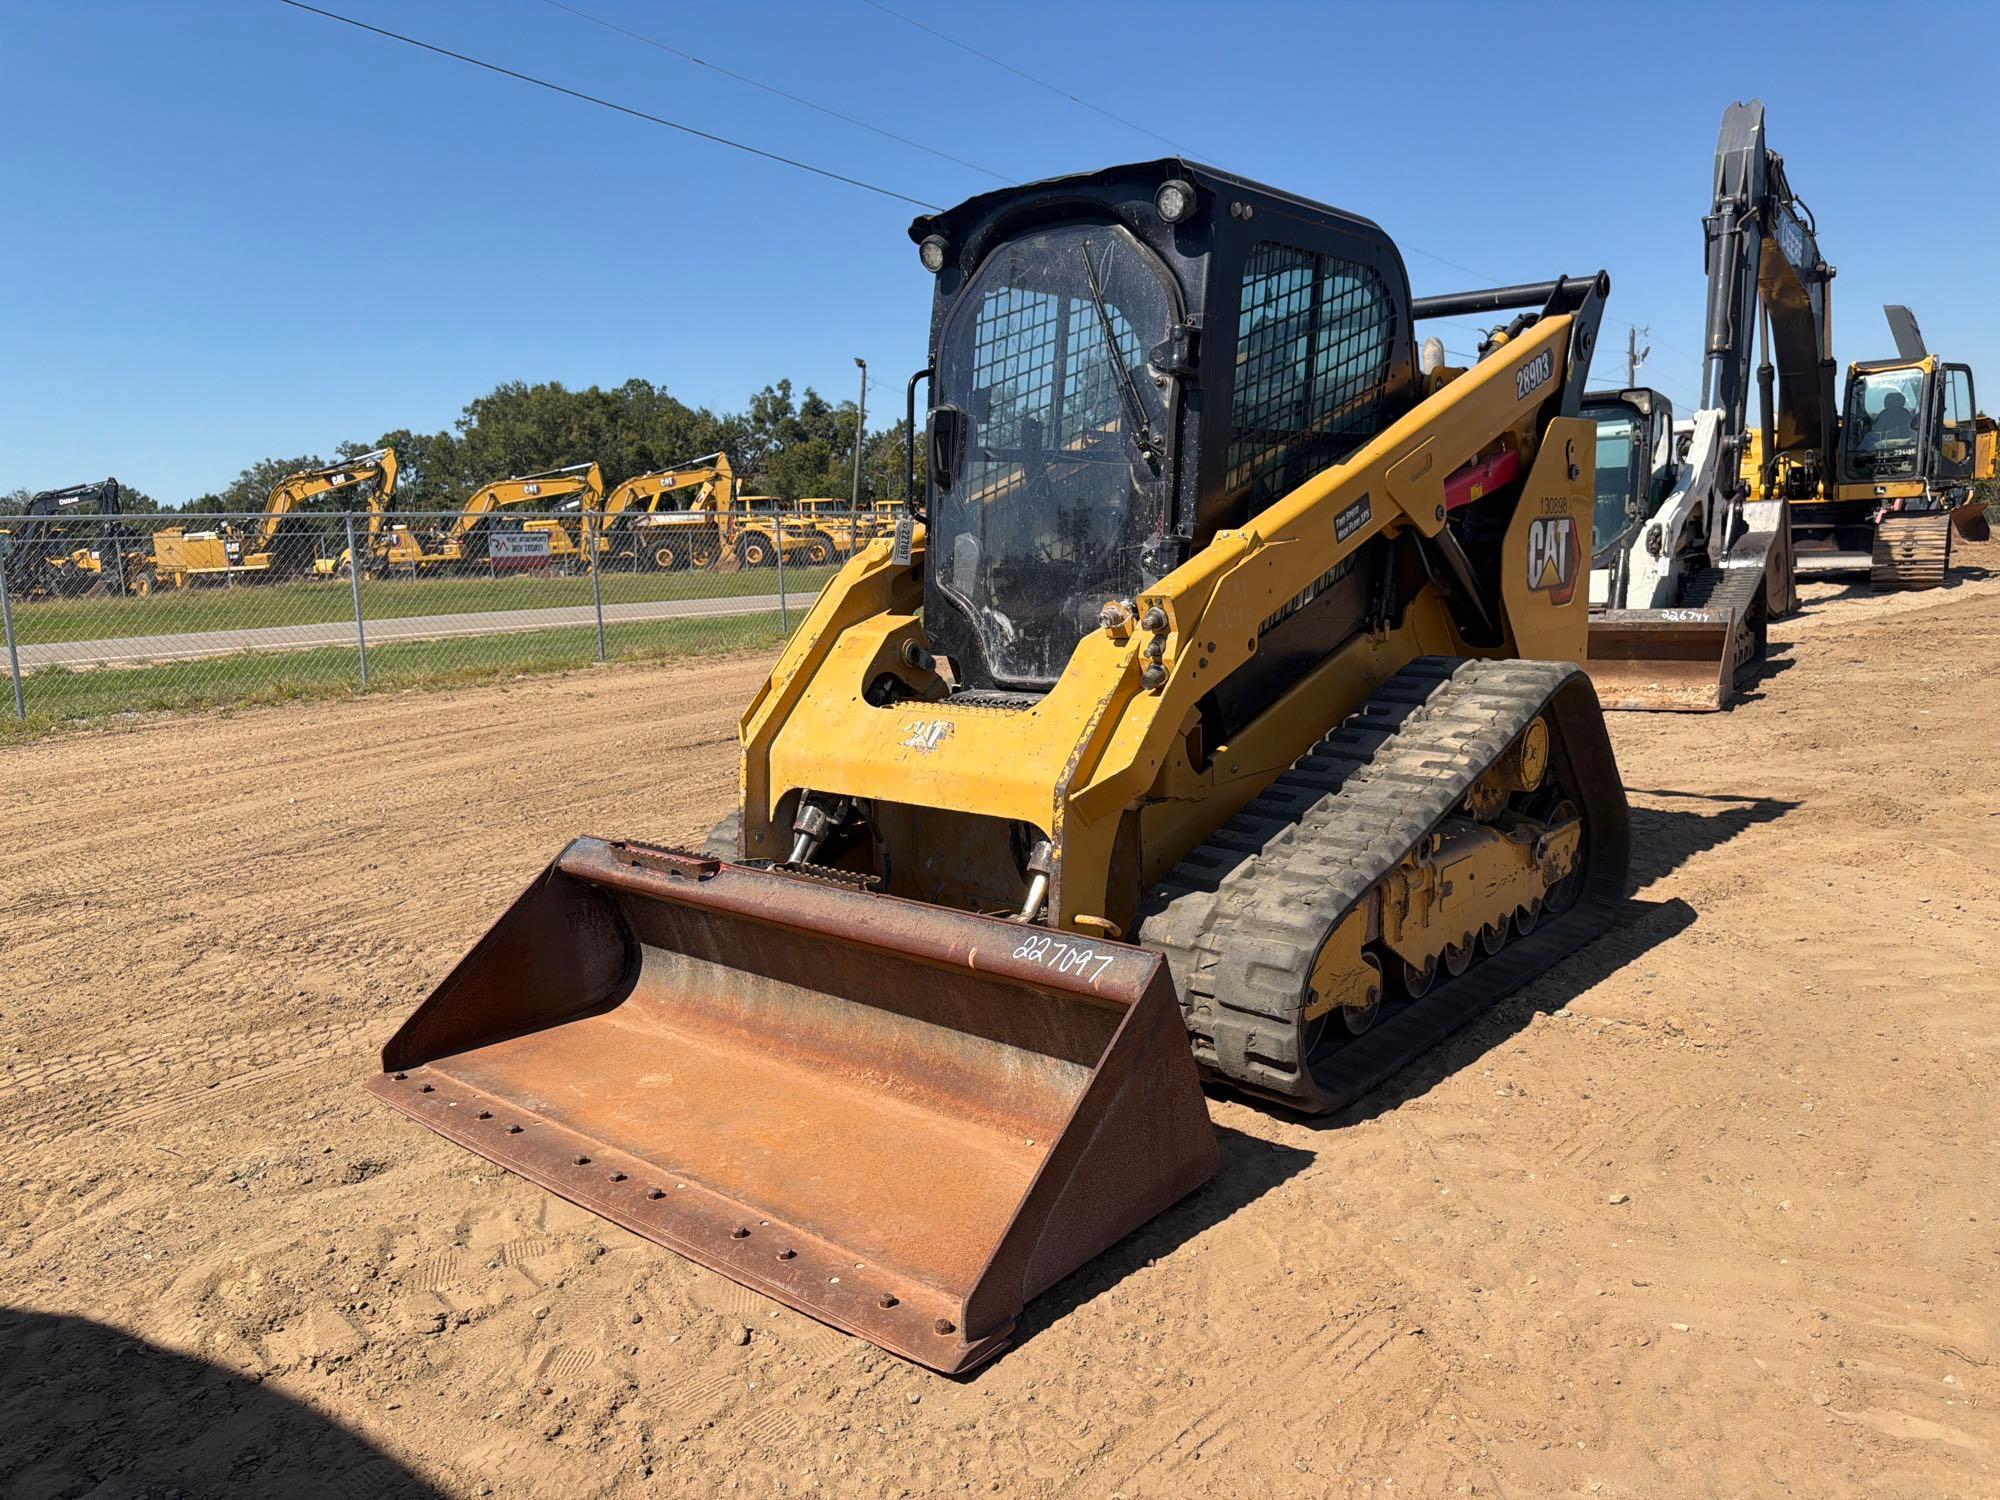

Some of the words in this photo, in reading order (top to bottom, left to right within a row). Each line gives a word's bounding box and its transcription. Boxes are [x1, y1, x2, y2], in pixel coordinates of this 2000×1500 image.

[1516, 351, 1549, 400] 289D3
[331, 474, 346, 486] CAT
[524, 484, 538, 494] CAT
[660, 477, 672, 487] CAT
[899, 529, 910, 560] 227097
[1528, 519, 1570, 588] CAT
[1661, 609, 1709, 622] 226744
[1013, 935, 1114, 984] 227097
